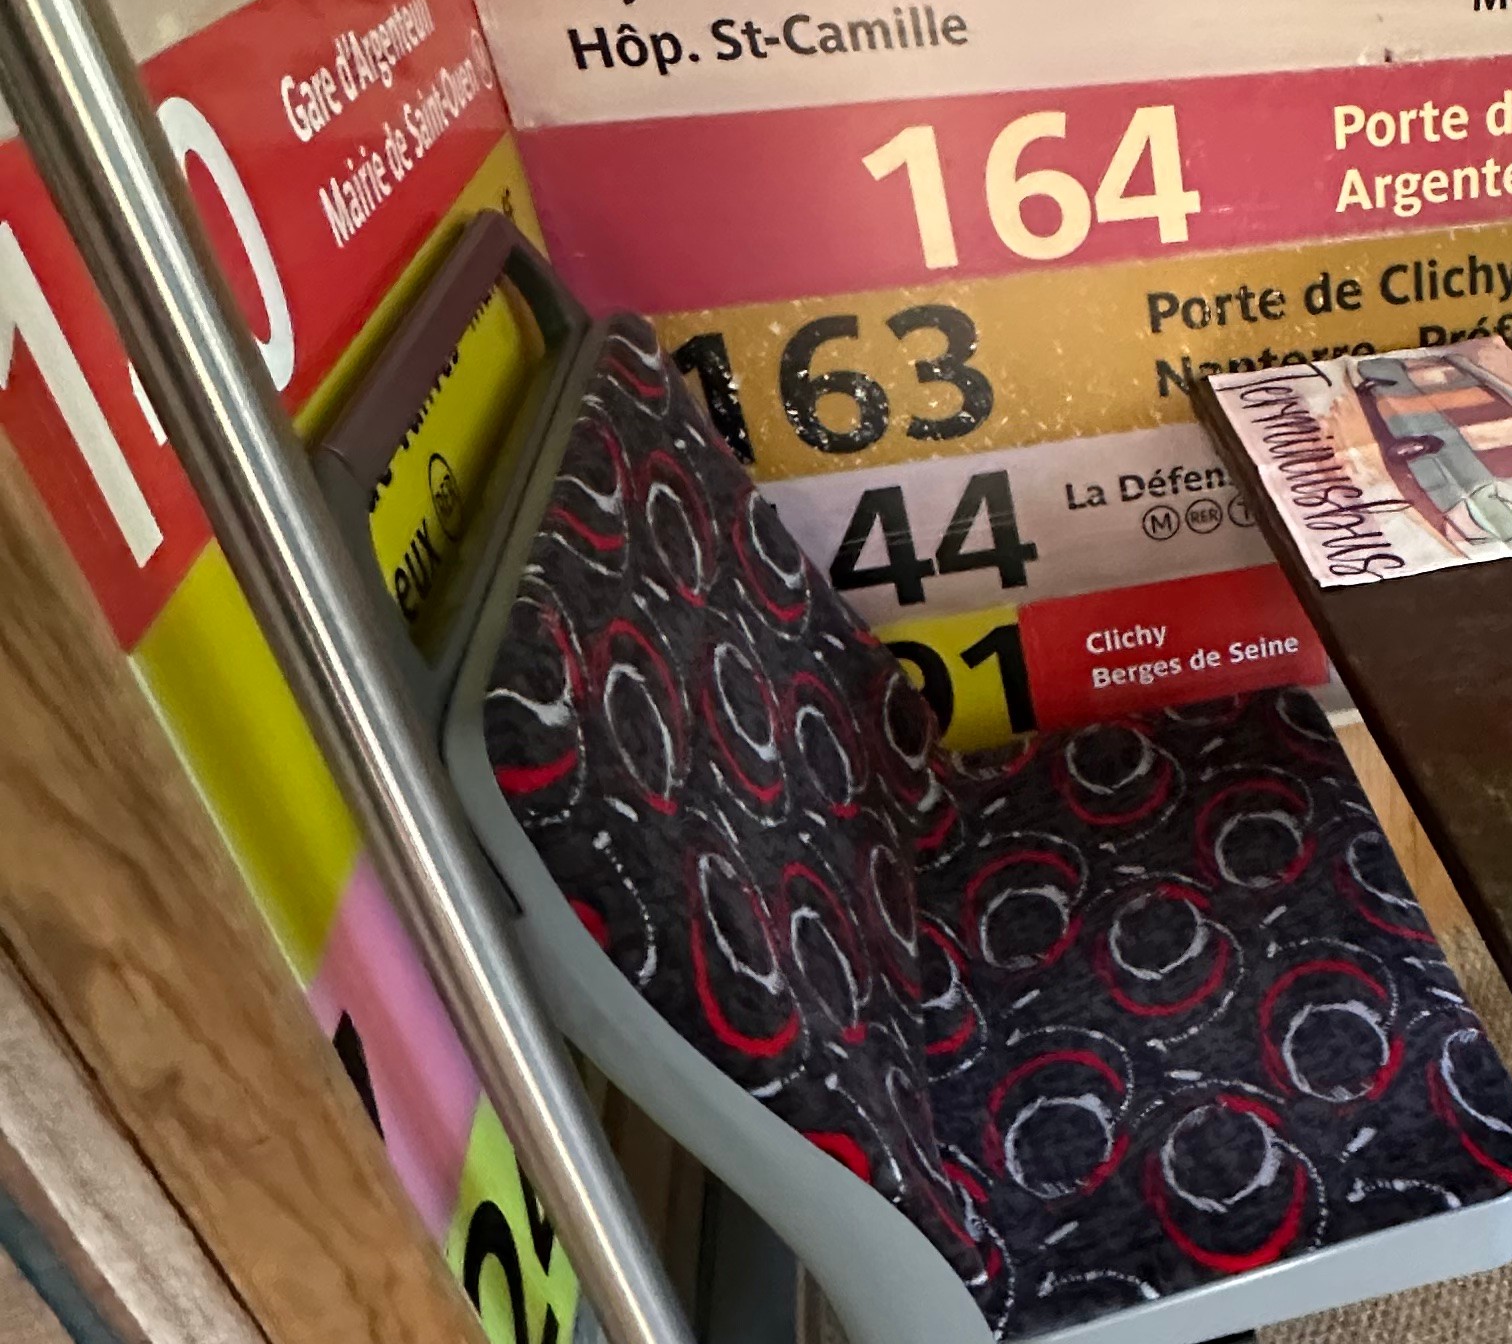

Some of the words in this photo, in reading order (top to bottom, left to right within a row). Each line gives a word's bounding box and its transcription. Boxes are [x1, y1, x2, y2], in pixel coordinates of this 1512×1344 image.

[567, 23, 700, 77] Hôp.
[711, 6, 969, 62] St-Camille
[280, 67, 342, 143] Gare
[1334, 103, 1470, 150] Porte
[319, 145, 392, 248] Mairie
[382, 121, 413, 182] de
[403, 58, 480, 158] Saint-Ouen
[861, 104, 1201, 270] 164
[1147, 286, 1287, 334] Porte
[1304, 273, 1362, 316] de
[663, 305, 995, 463] 163
[1065, 482, 1107, 510] La
[1118, 465, 1232, 503] Défen
[770, 469, 1038, 606] 44
[1086, 623, 1167, 656] Clichy
[1091, 656, 1182, 690] Berges
[1191, 648, 1221, 671] de
[1228, 632, 1299, 663] Seine
